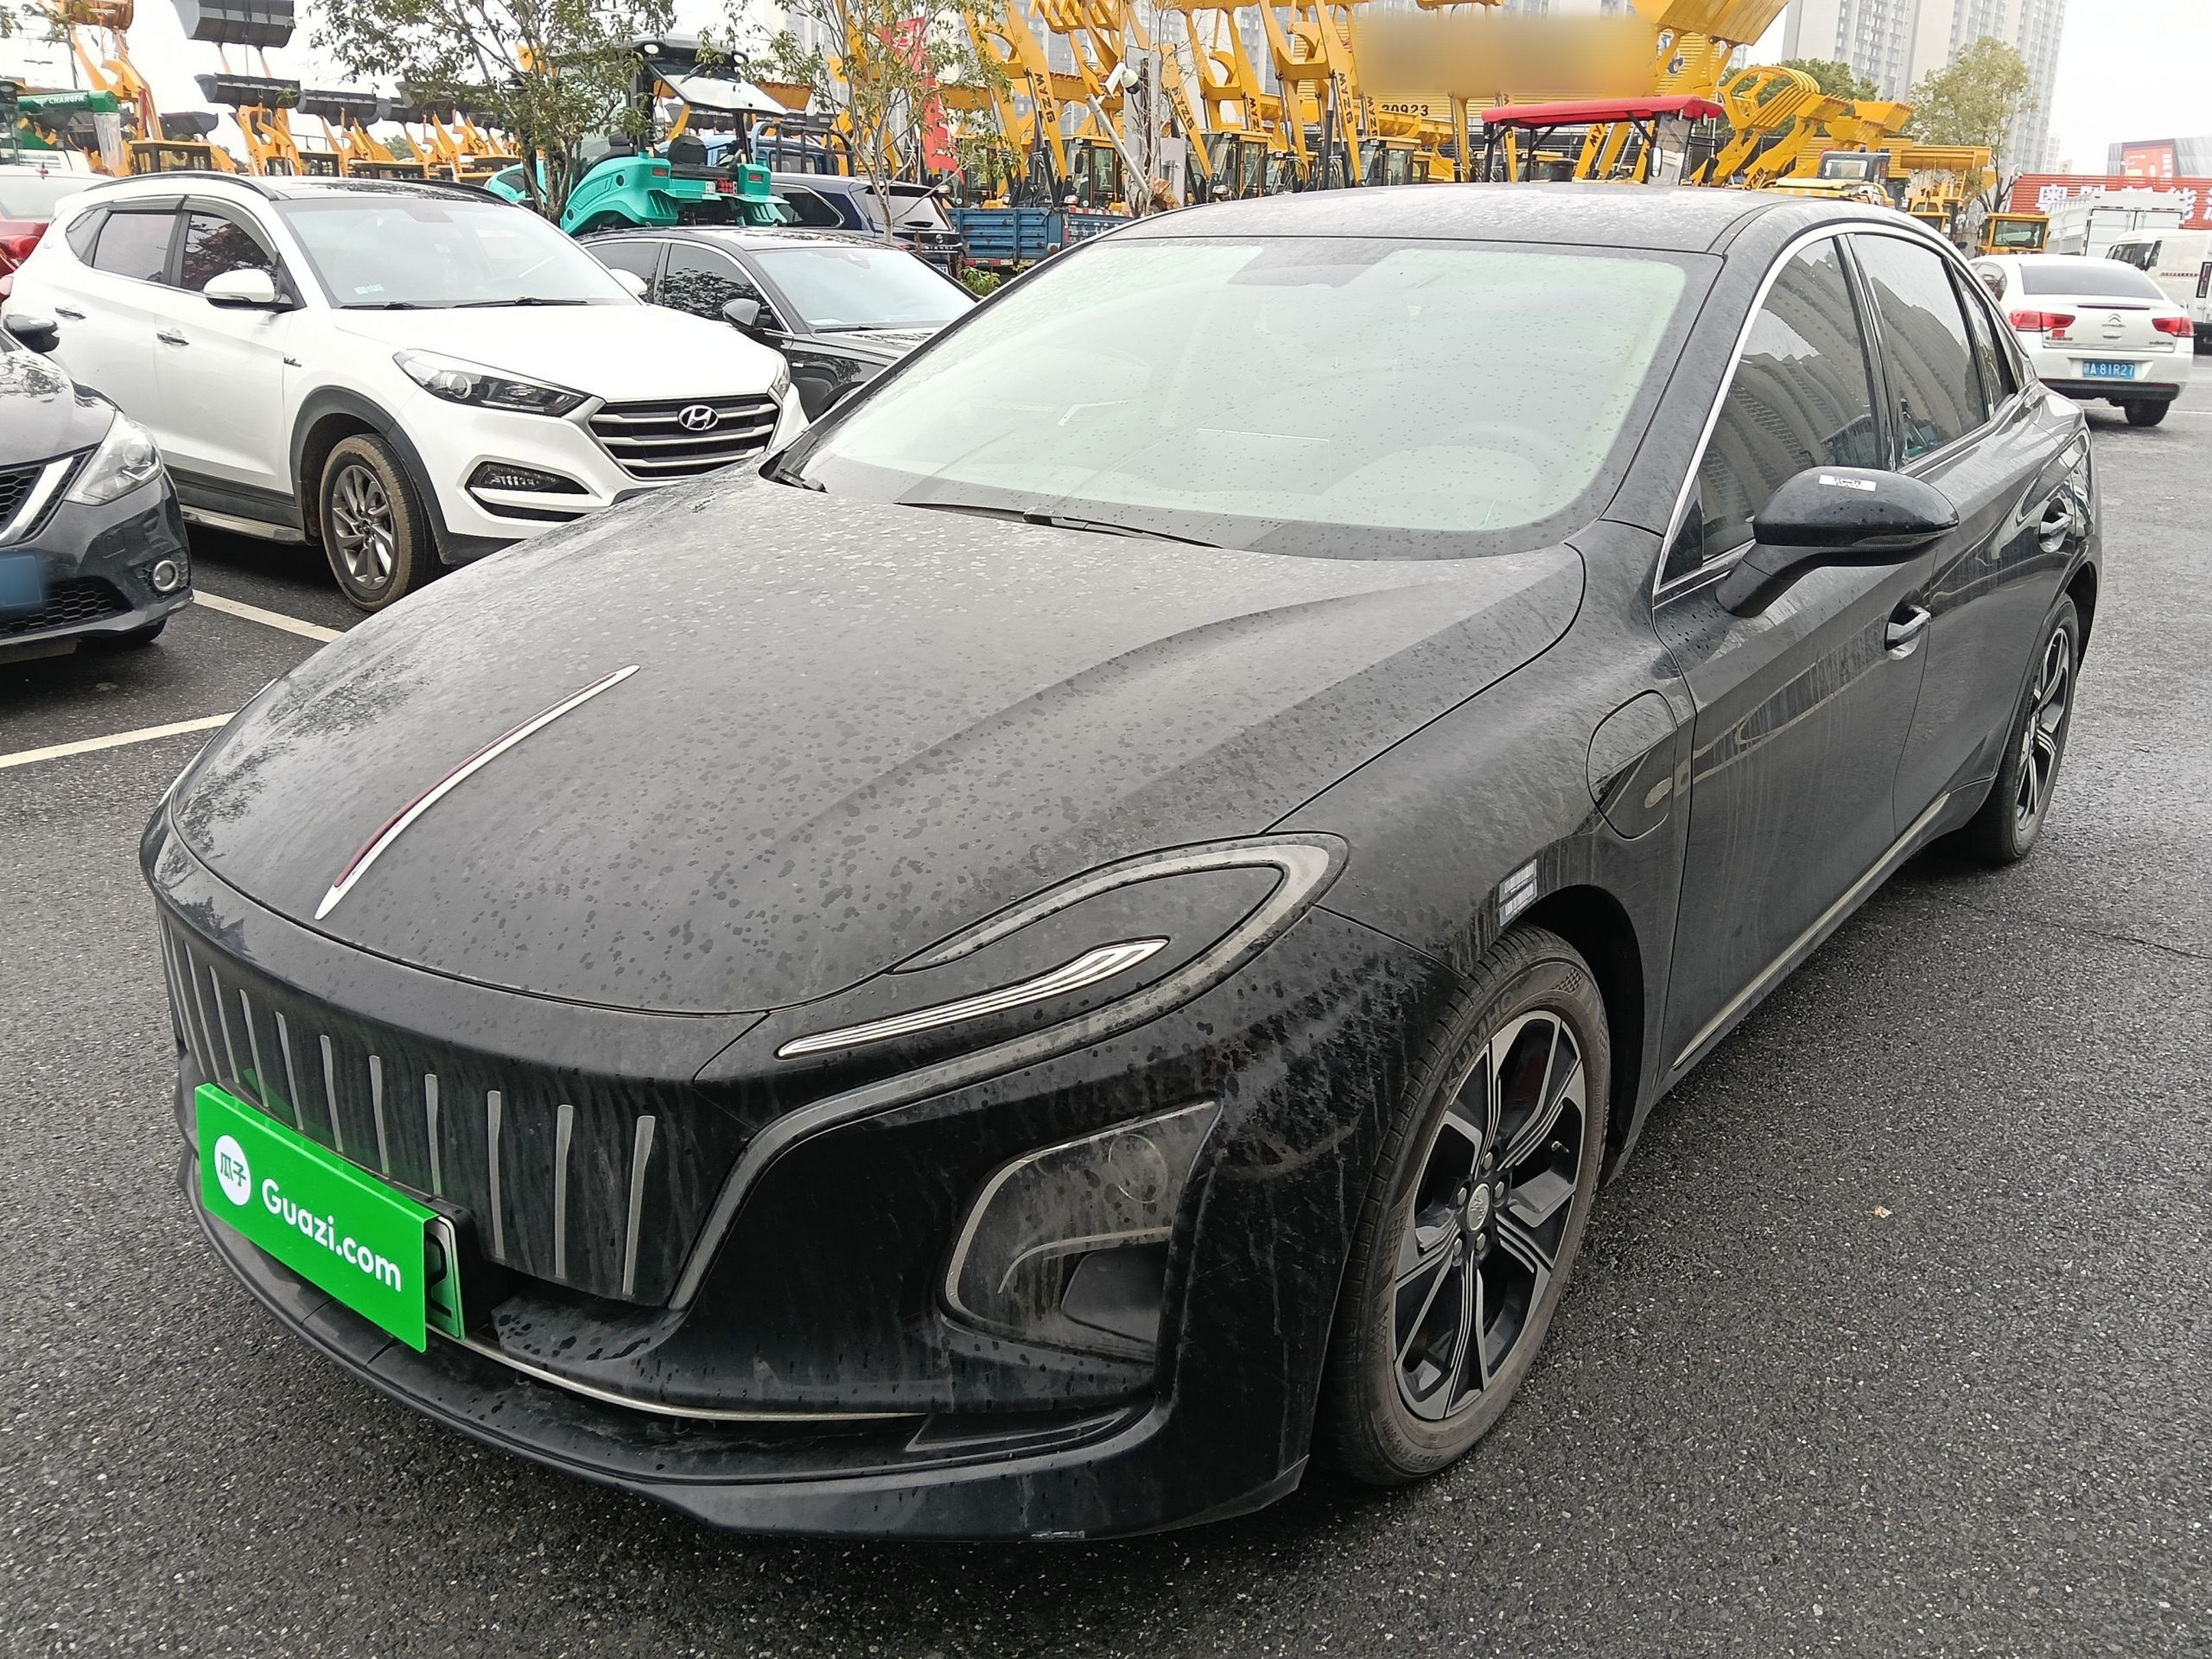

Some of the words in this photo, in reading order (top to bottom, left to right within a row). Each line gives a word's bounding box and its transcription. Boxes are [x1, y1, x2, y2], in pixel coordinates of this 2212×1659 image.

[48, 94, 84, 104] CHANGFA
[1441, 991, 1515, 1098] KUMHO
[219, 1152, 247, 1187] 瓜子
[261, 1178, 402, 1293] Guazi.com
